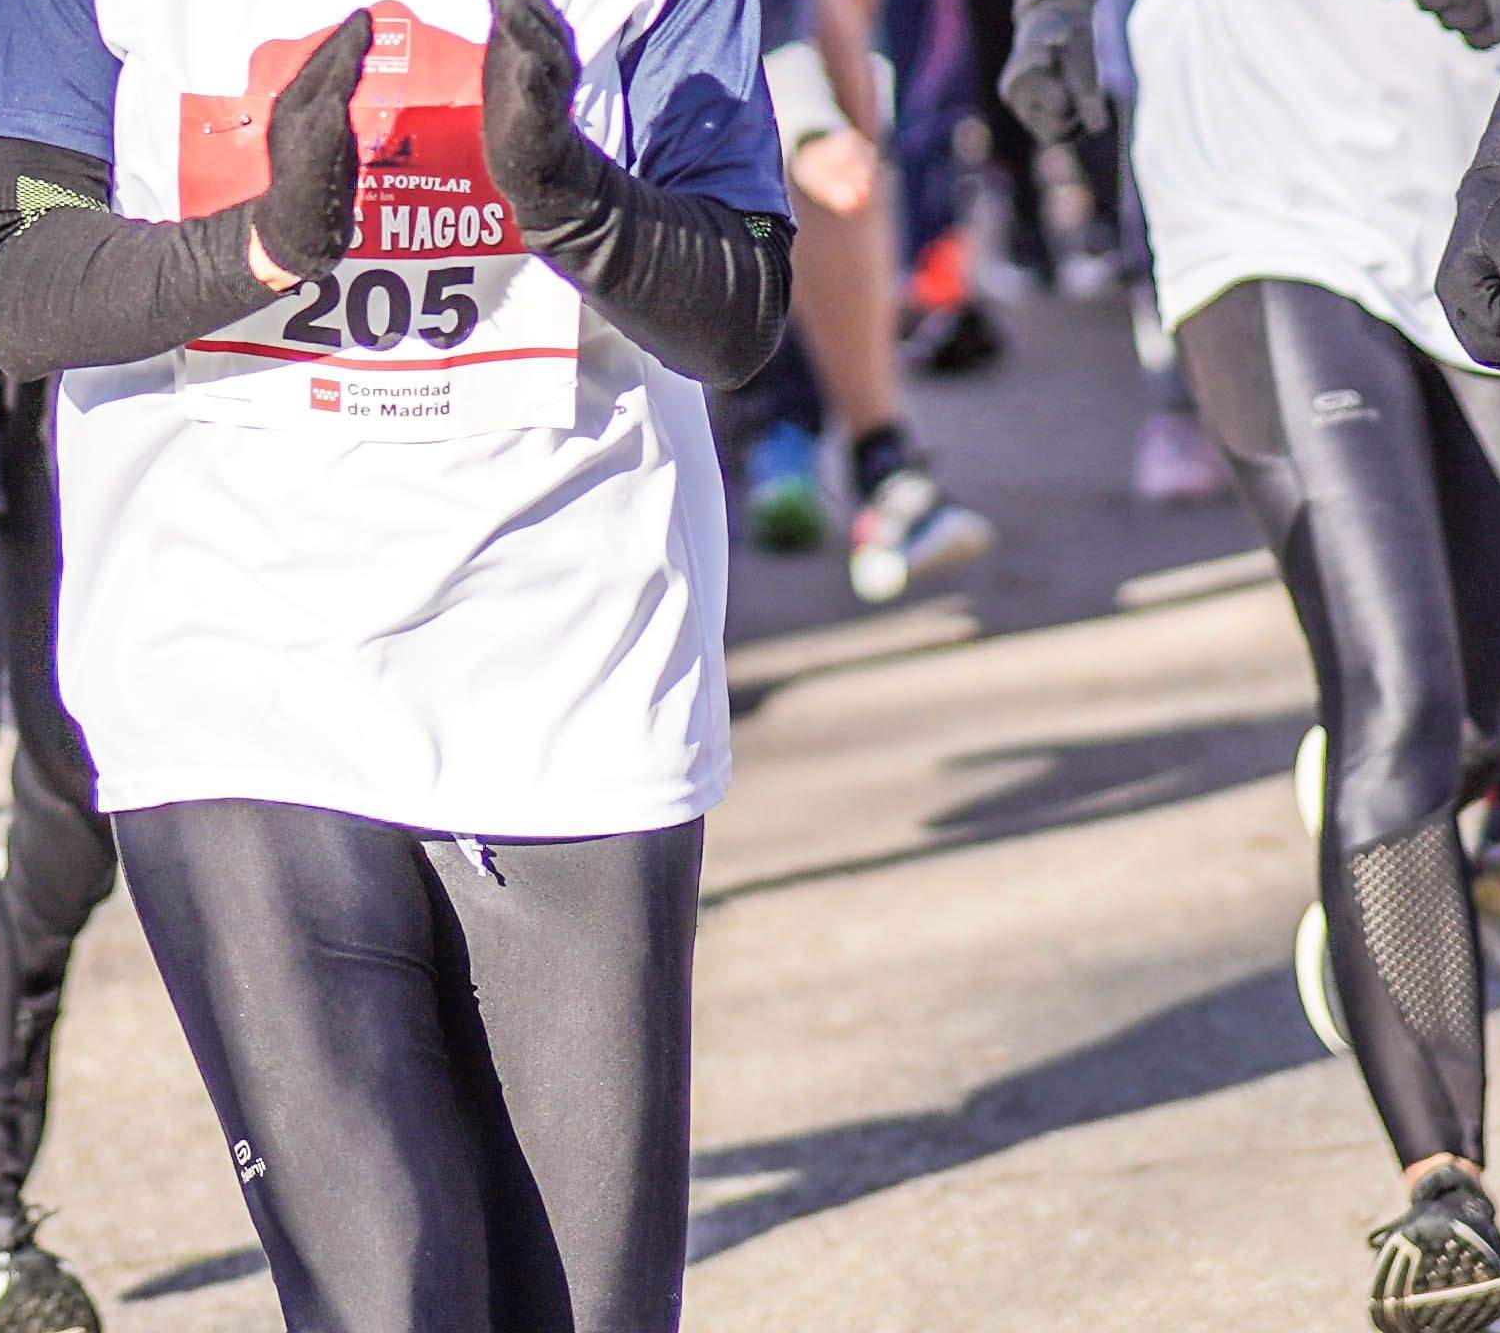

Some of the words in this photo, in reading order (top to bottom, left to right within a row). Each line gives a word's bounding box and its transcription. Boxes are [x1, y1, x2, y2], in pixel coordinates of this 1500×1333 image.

[382, 174, 472, 194] POPULAR
[380, 201, 505, 252] MAGOS
[283, 265, 478, 352] 205
[347, 381, 451, 397] Comunidad
[347, 402, 371, 416] de
[380, 400, 451, 418] Madrid
